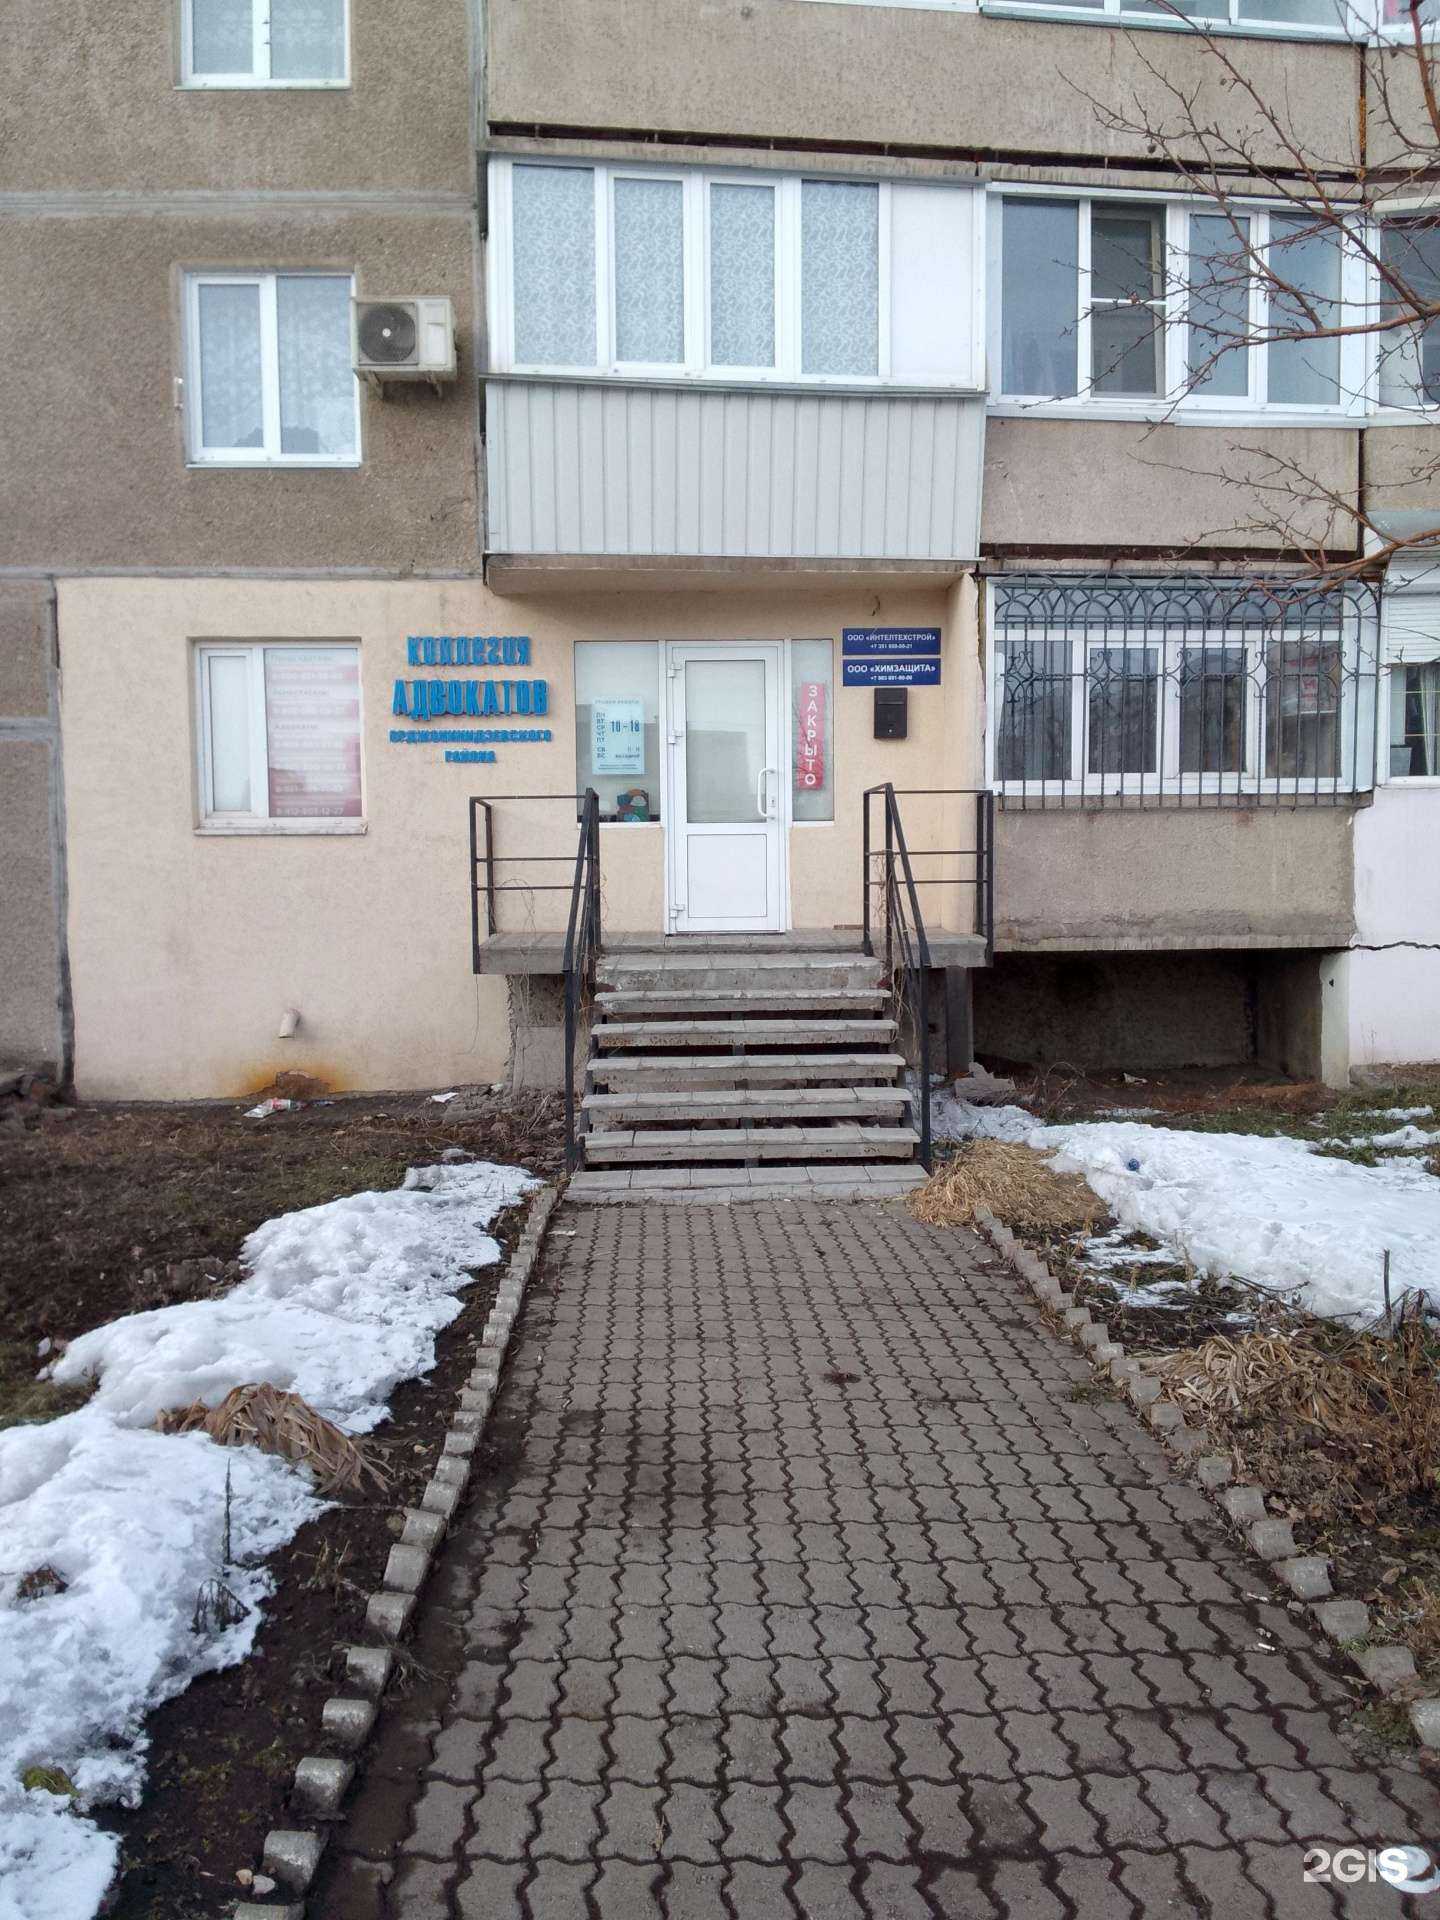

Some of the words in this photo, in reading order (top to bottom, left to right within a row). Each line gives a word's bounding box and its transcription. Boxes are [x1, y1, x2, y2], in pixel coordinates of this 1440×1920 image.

[847, 664, 868, 673] ООО
[870, 663, 936, 674] «ХИМЗАЩИТА»
[393, 680, 549, 720] АДВОКАТОВ
[804, 685, 818, 785] ЗАКРЫТО
